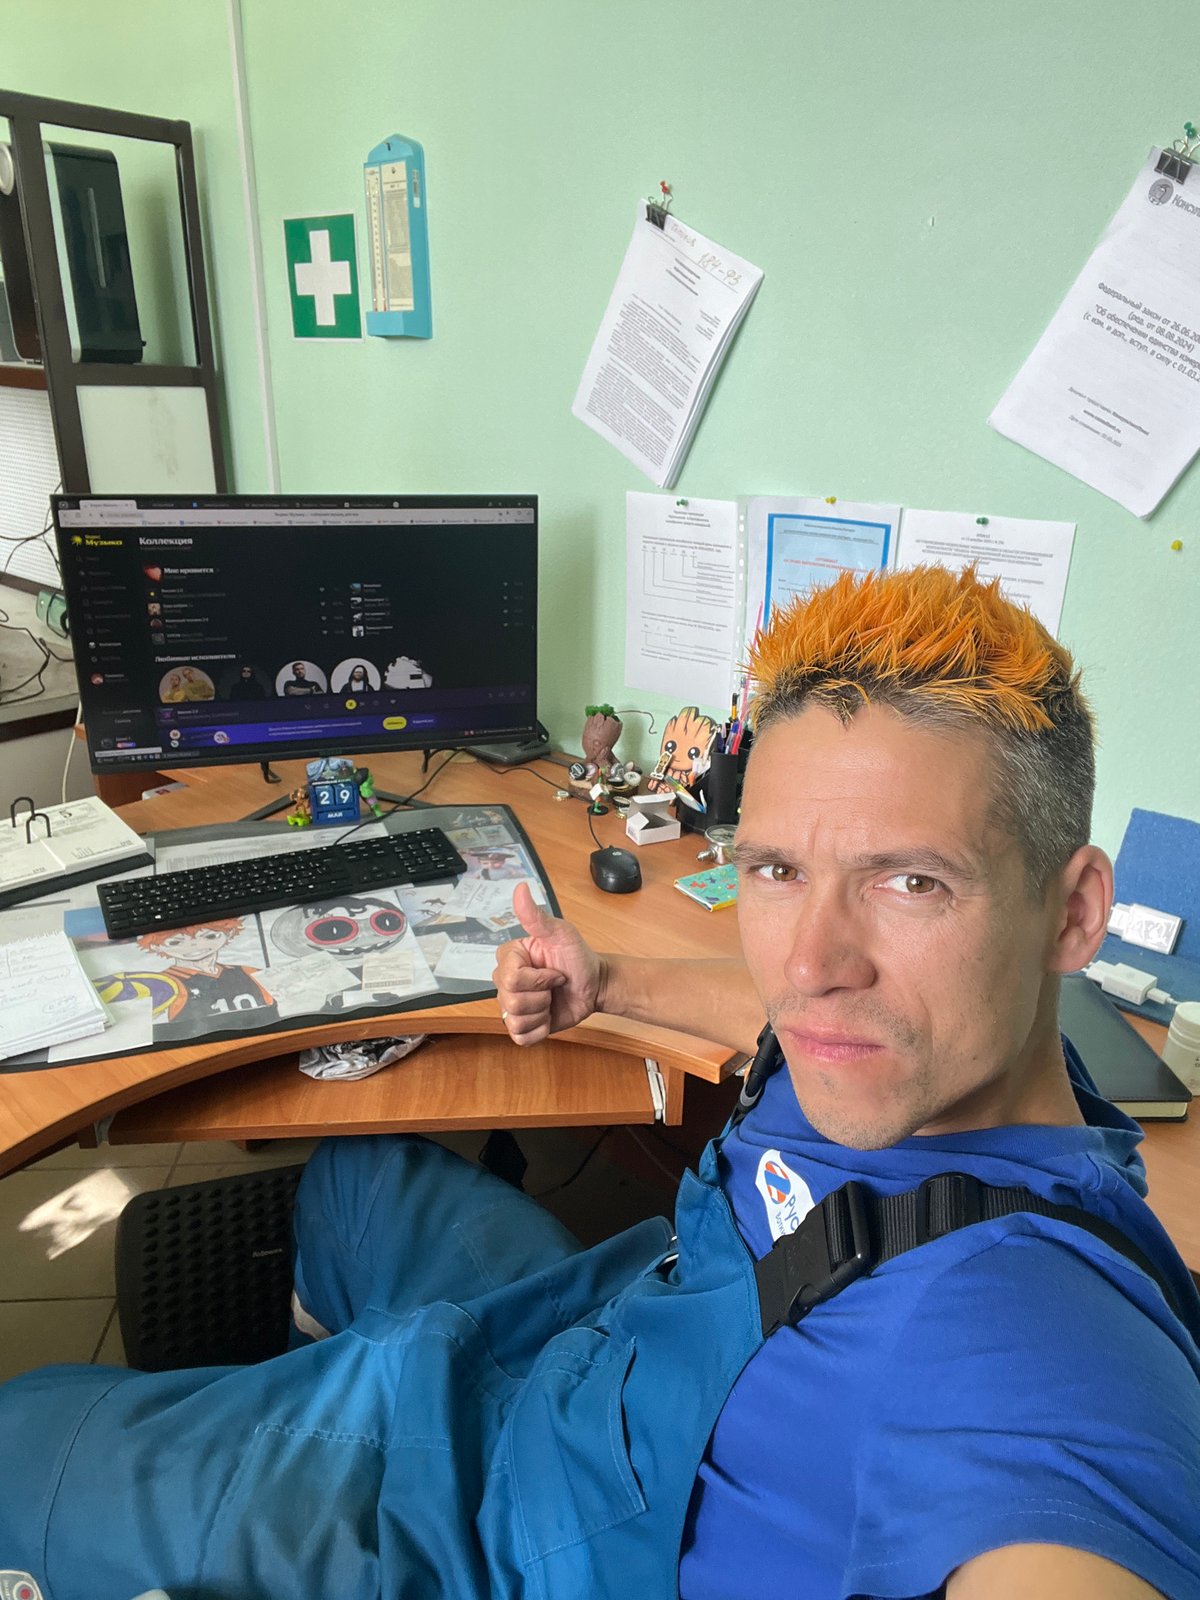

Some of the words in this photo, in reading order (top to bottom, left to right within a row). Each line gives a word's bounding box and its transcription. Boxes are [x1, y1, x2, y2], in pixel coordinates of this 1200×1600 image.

[1098, 282, 1143, 310] Федеральный
[1142, 307, 1162, 320] закон
[1162, 318, 1171, 326] от
[1146, 322, 1156, 330] от
[1106, 313, 1148, 339] обеспечении
[1148, 336, 1179, 356] единства
[1155, 352, 1172, 367] силу
[85, 538, 123, 547] Музыка
[139, 537, 194, 546] Коллекция
[179, 567, 214, 575] нравится
[59, 809, 73, 818] 5
